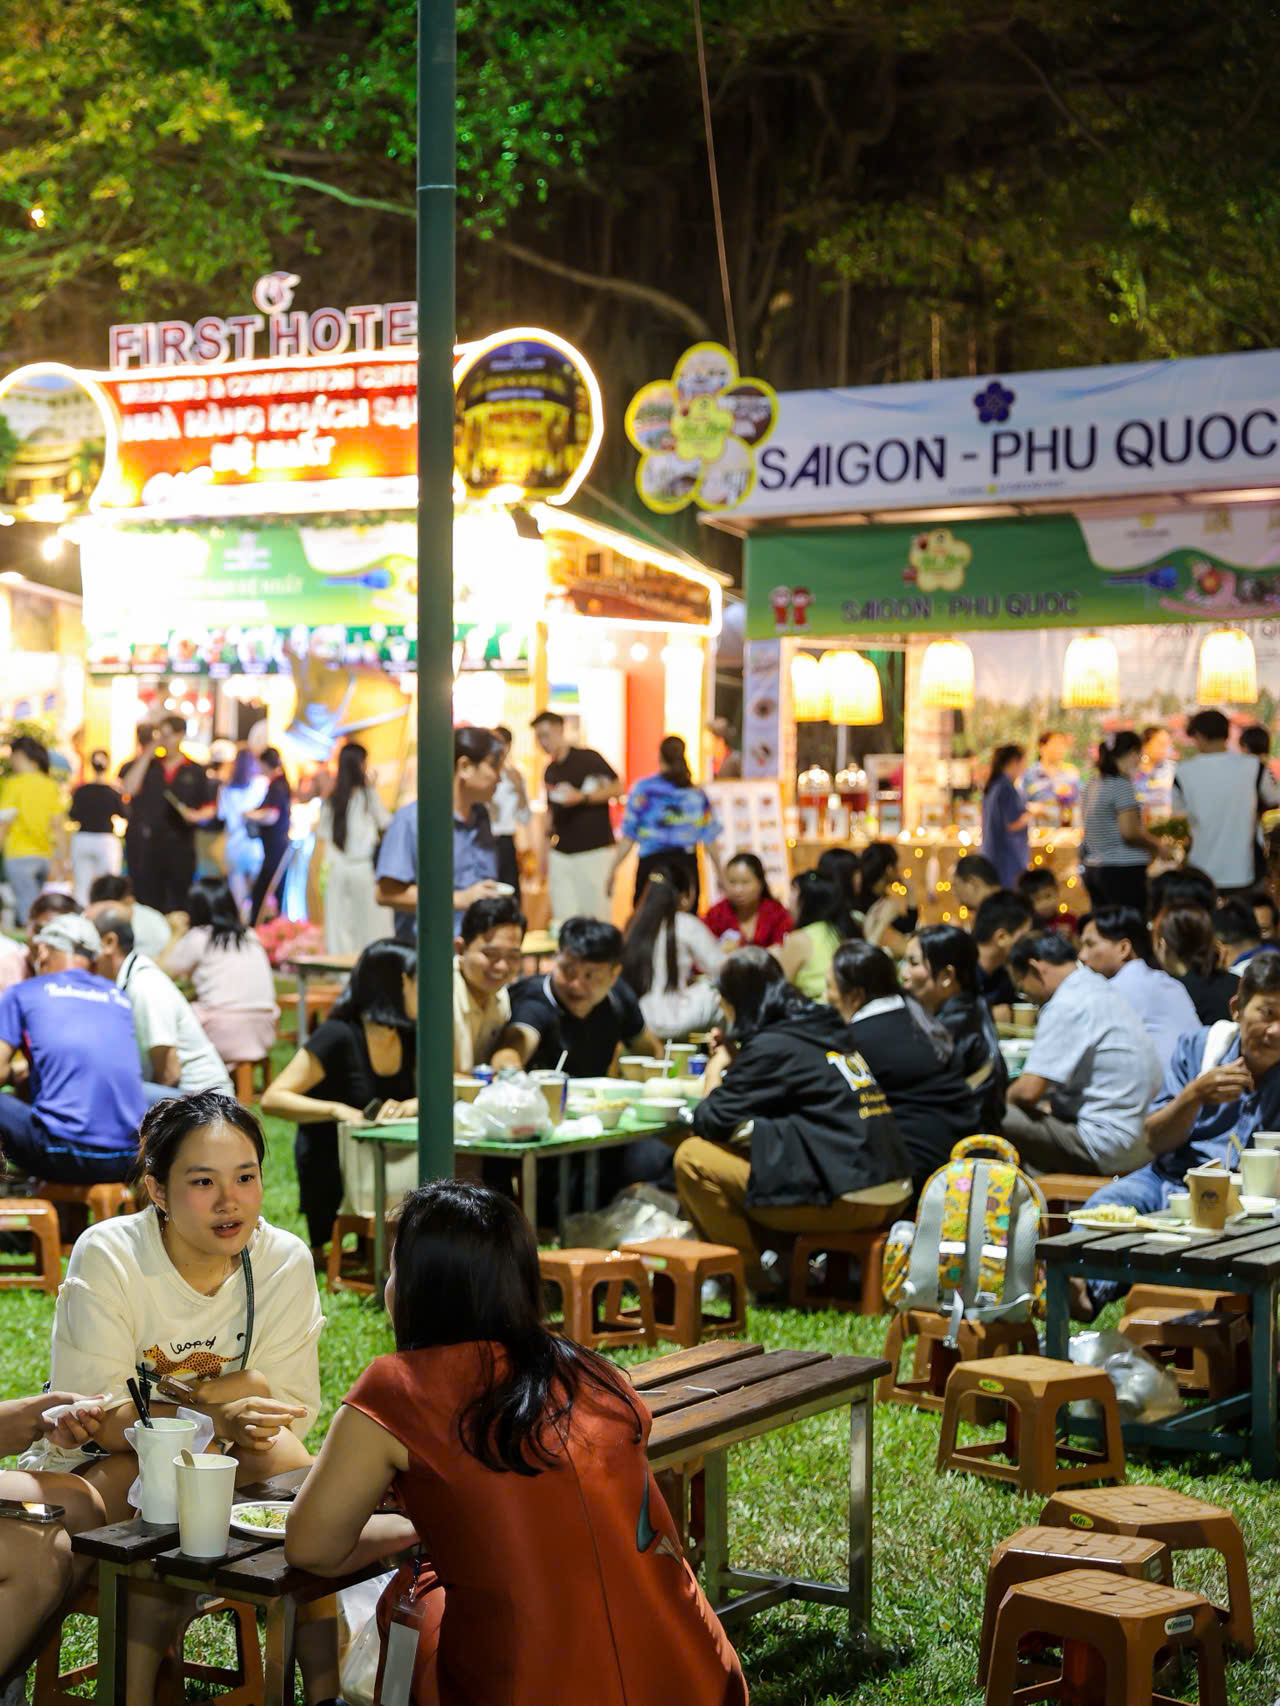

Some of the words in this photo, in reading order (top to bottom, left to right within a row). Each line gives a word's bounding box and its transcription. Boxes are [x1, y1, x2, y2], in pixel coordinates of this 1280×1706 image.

[109, 314, 264, 370] FIRST
[272, 300, 418, 358] HOTE
[373, 396, 418, 429] SẠ
[759, 436, 946, 490] SAIGON
[991, 424, 1097, 476] PHU
[1115, 408, 1278, 470] QUOC
[841, 595, 932, 624] SAIGON
[948, 593, 1001, 618] PHU
[1005, 590, 1081, 617] QUOC
